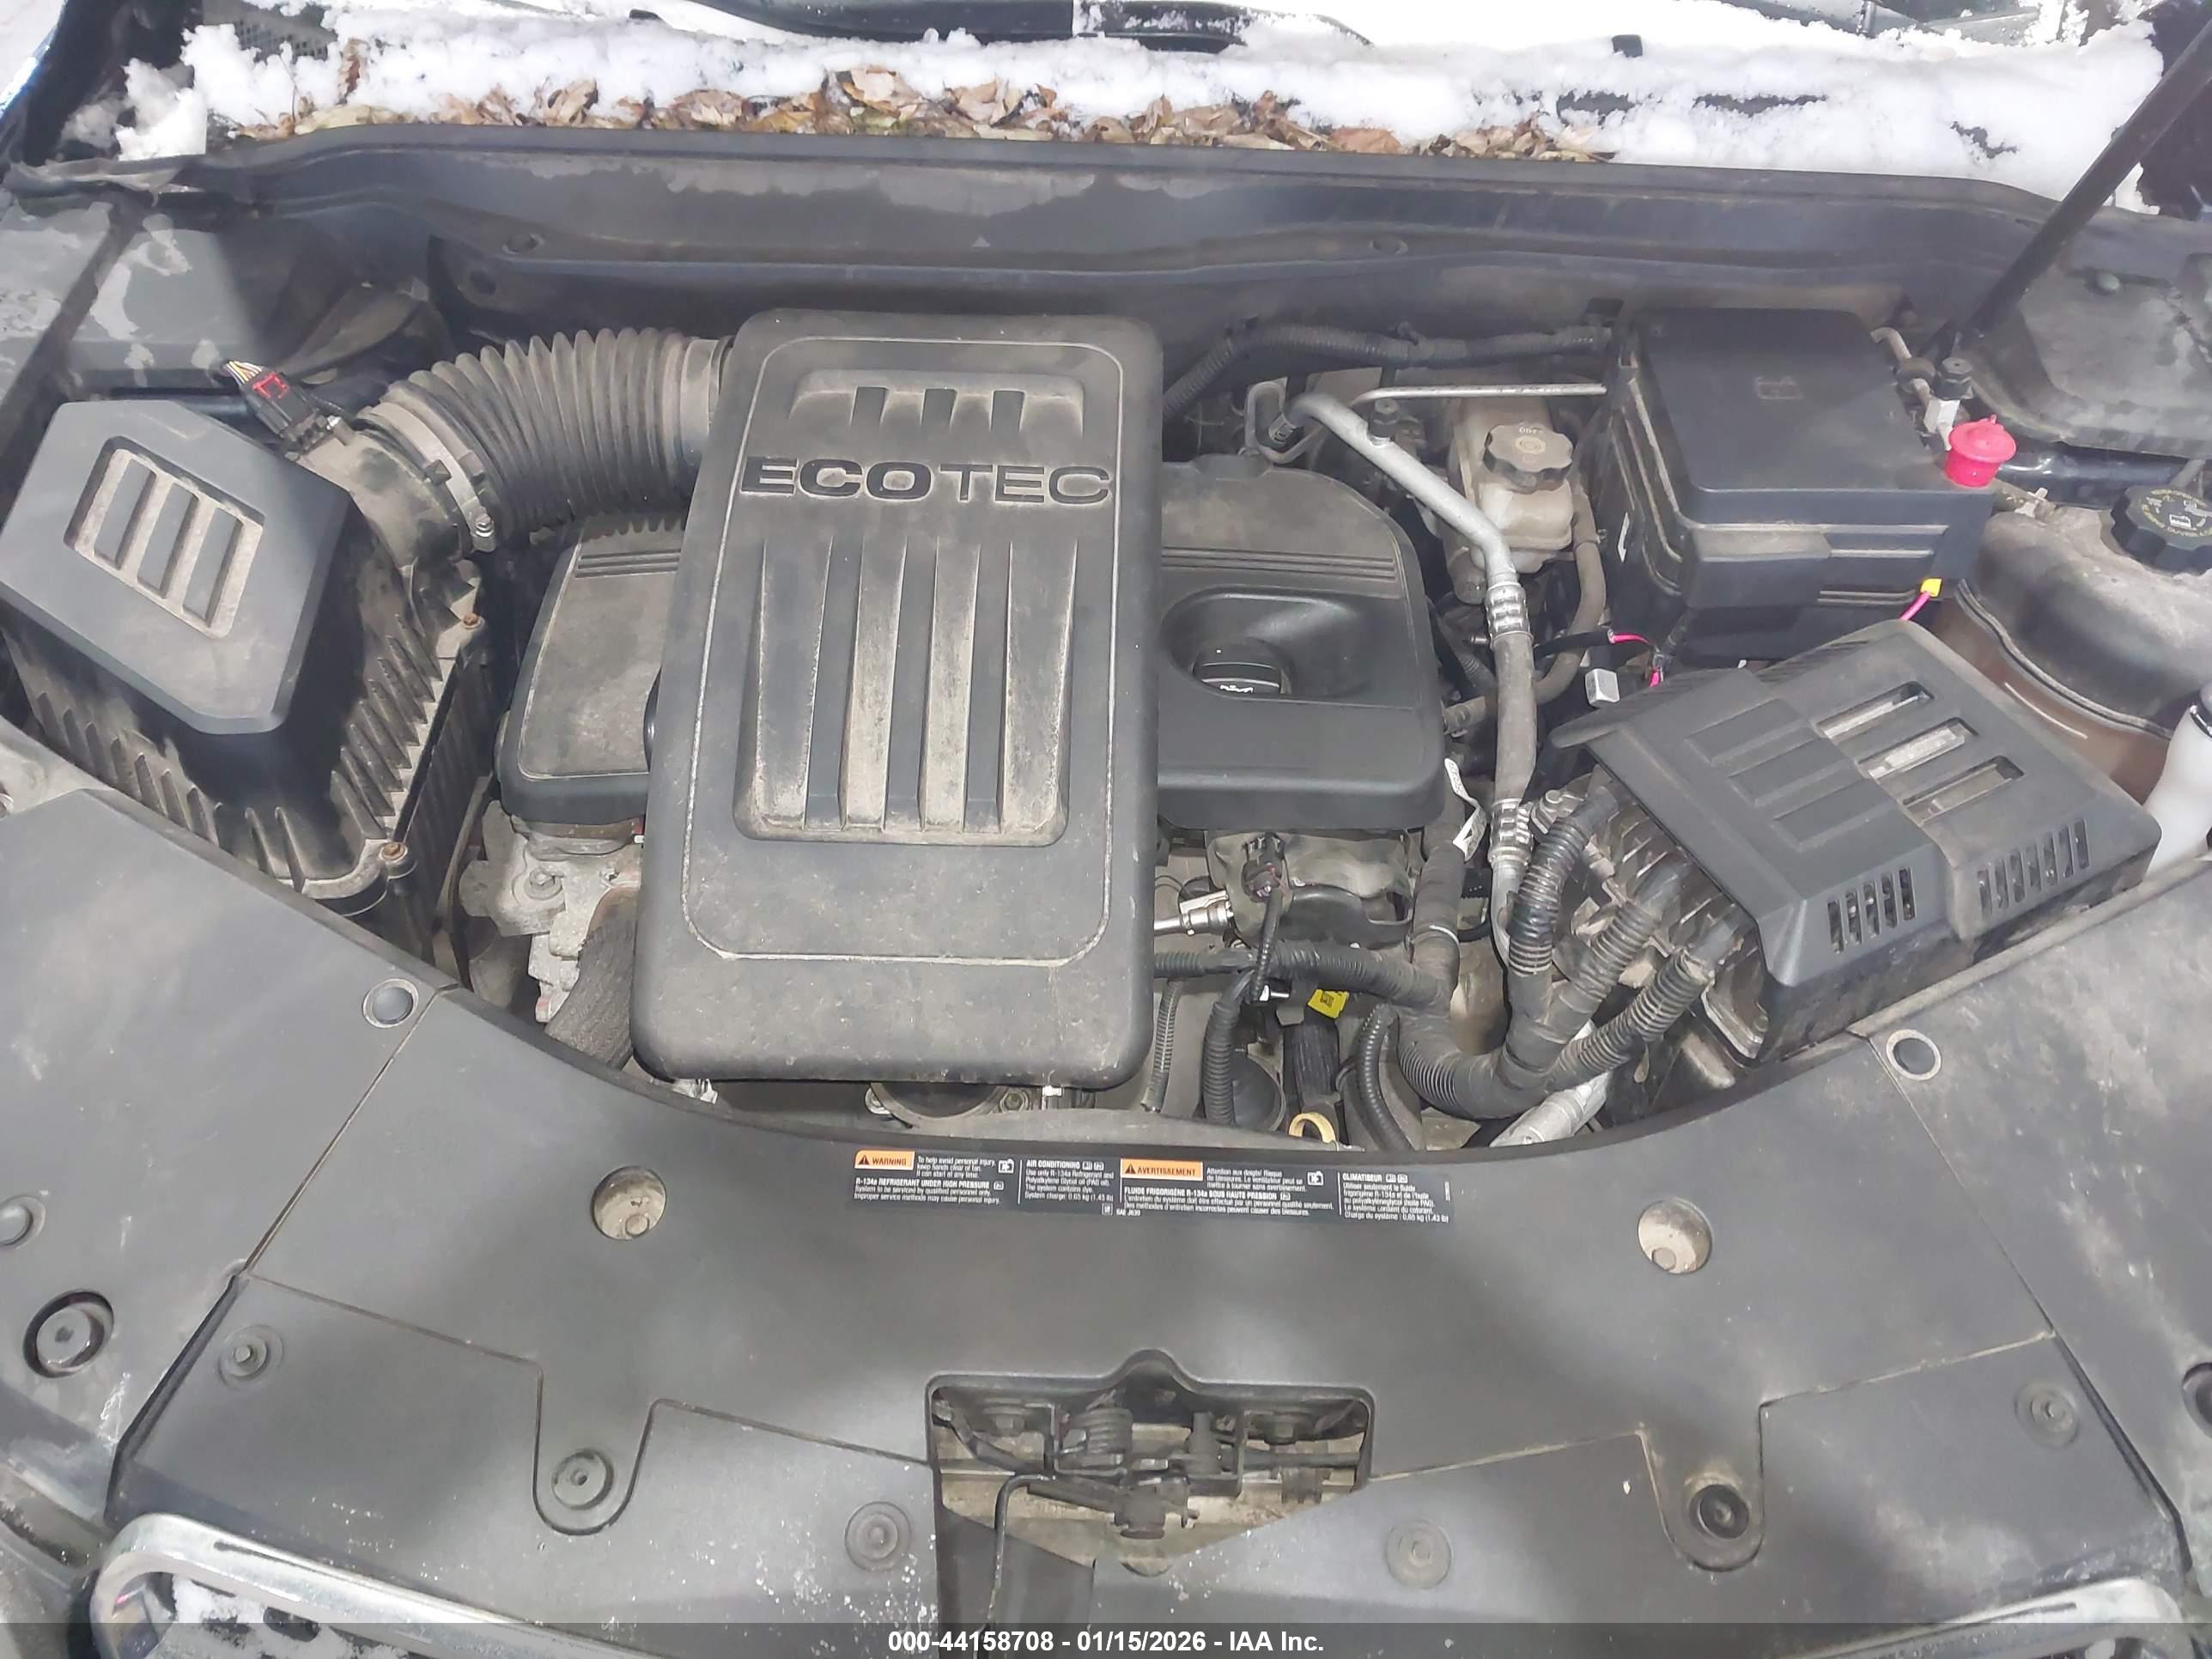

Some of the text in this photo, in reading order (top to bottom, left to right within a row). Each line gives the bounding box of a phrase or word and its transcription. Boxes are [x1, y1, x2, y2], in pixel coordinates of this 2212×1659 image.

[739, 456, 1112, 505] ECOTEC
[1038, 1160, 1080, 1169] CONDITIONING
[1138, 1167, 1195, 1176] AVERTISSEMENT
[1342, 1173, 1382, 1182] CLIMATISEUR
[878, 1178, 920, 1187] REFRIGERANT
